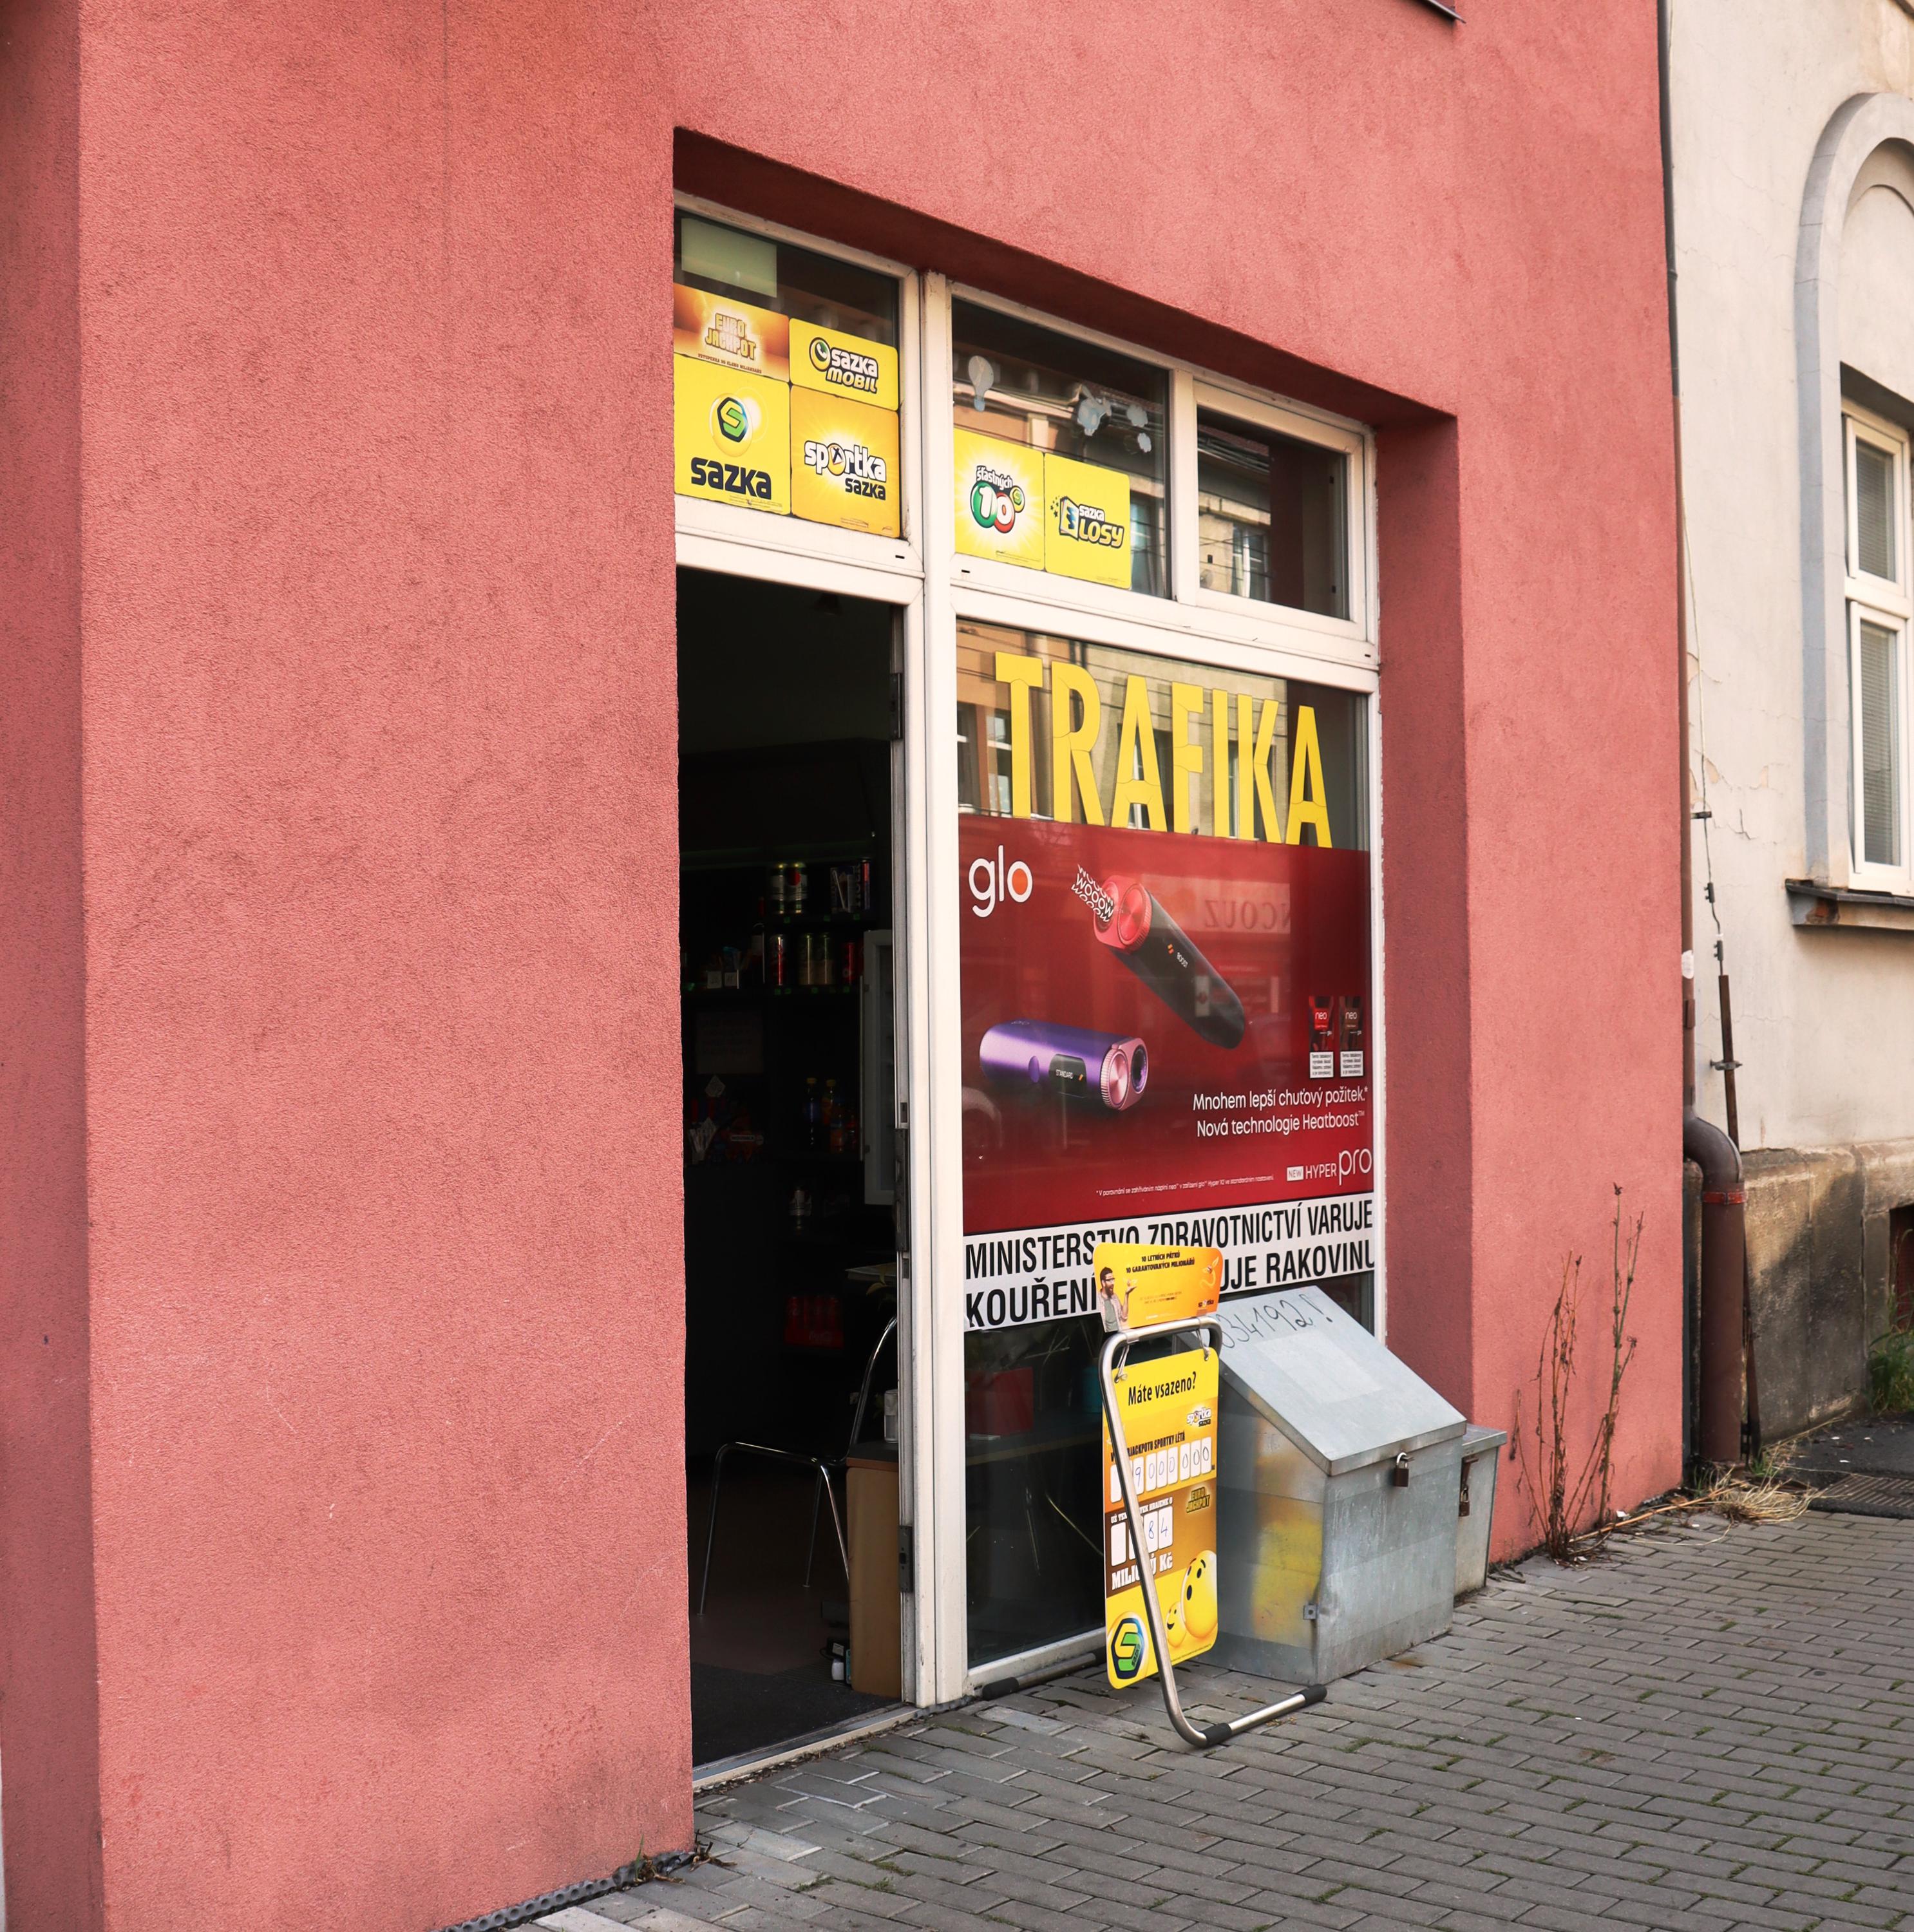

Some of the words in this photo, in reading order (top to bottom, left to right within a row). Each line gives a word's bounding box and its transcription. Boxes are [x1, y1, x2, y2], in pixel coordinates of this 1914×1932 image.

[715, 313, 746, 339] EURO
[705, 328, 757, 360] JACKPOT
[995, 650, 1332, 848] TRAFIKA
[968, 844, 1033, 918] glo
[1076, 873, 1114, 918] WOOOW
[1314, 1012, 1328, 1020] neo
[1345, 1012, 1358, 1020] neo
[1193, 1092, 1246, 1111] Mnohem
[1249, 1089, 1276, 1111] lepší
[1278, 1086, 1323, 1108] chuťový
[1197, 1117, 1229, 1137] Nová
[1231, 1114, 1300, 1135] technologie
[1288, 1169, 1302, 1179] NEW
[1305, 1163, 1337, 1180] HYPER
[1339, 1148, 1372, 1186] pro
[1148, 1202, 1302, 1248] ZDRAVOTNICTVÍ
[1307, 1200, 1373, 1236] VARUJE
[1128, 1384, 1152, 1406] Máte
[1155, 1371, 1197, 1399] vsazeno?
[1159, 1551, 1173, 1572] Kč
